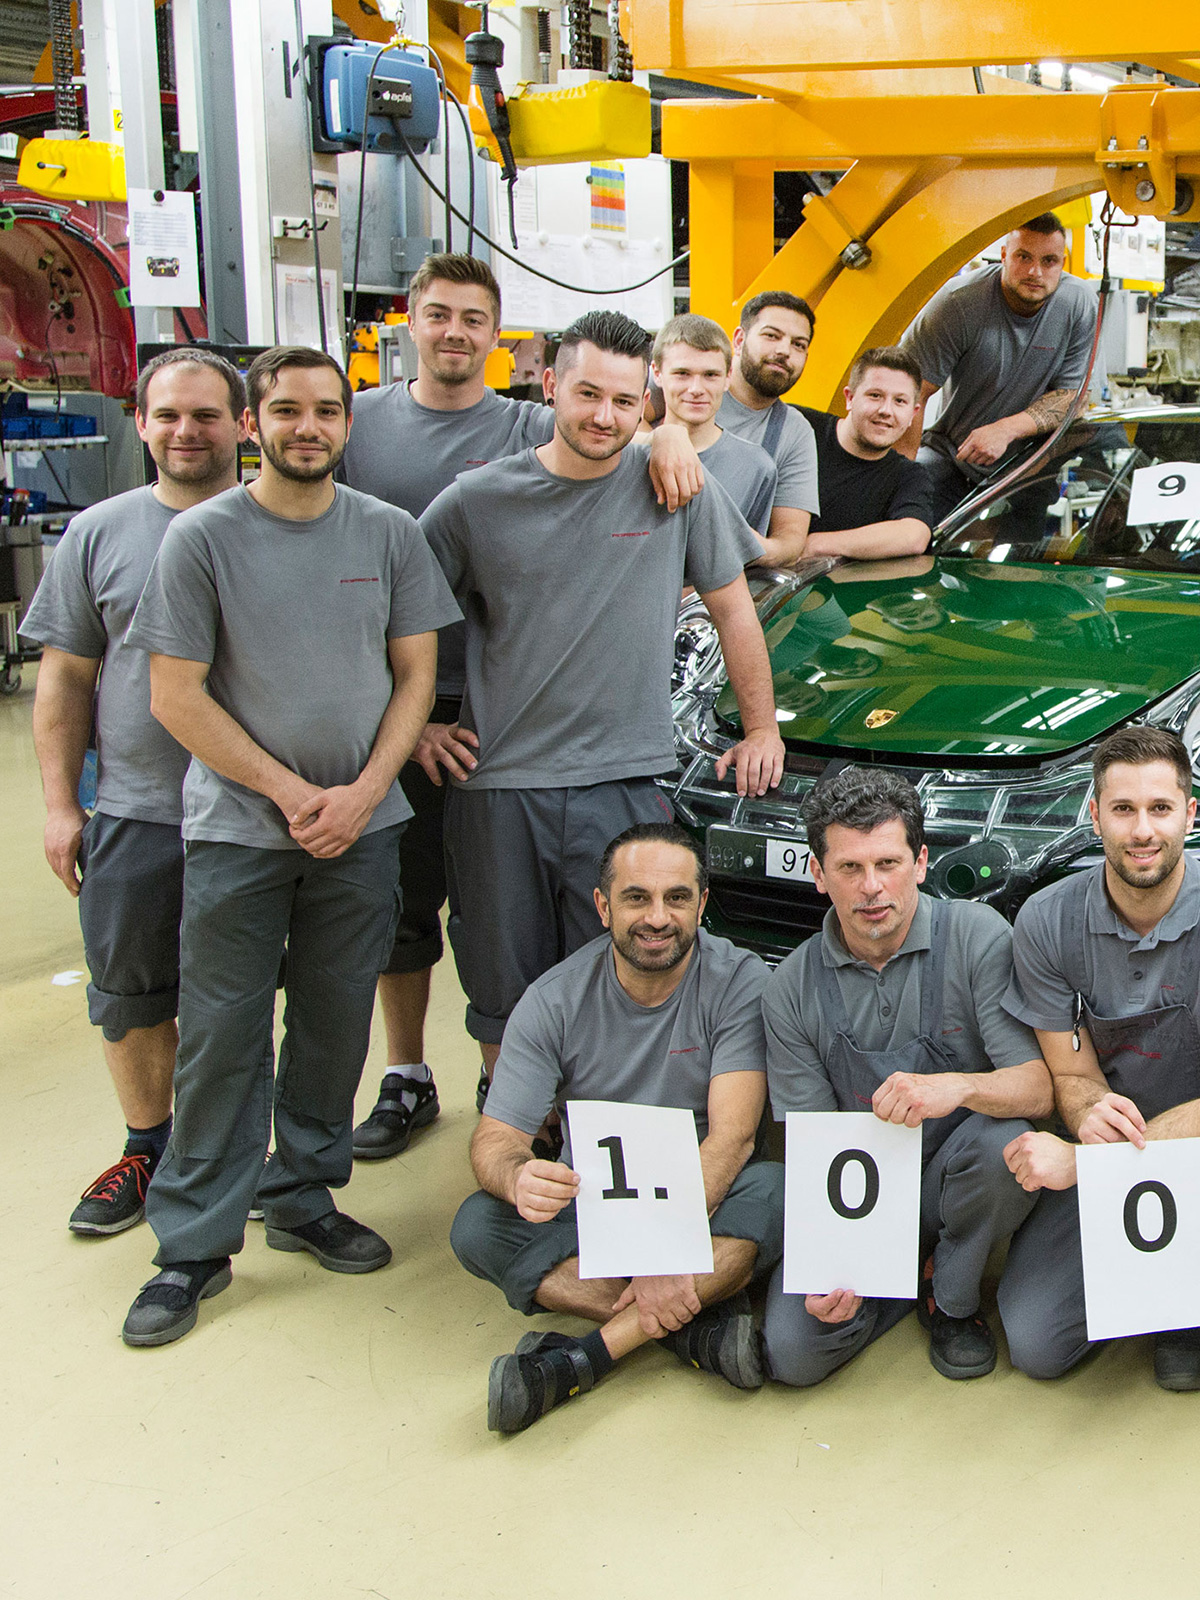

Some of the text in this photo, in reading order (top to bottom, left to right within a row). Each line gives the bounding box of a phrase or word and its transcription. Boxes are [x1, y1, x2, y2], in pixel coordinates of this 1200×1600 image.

[597, 1135, 669, 1200] 1.
[826, 1148, 880, 1220] 0
[1123, 1180, 1178, 1253] 0
